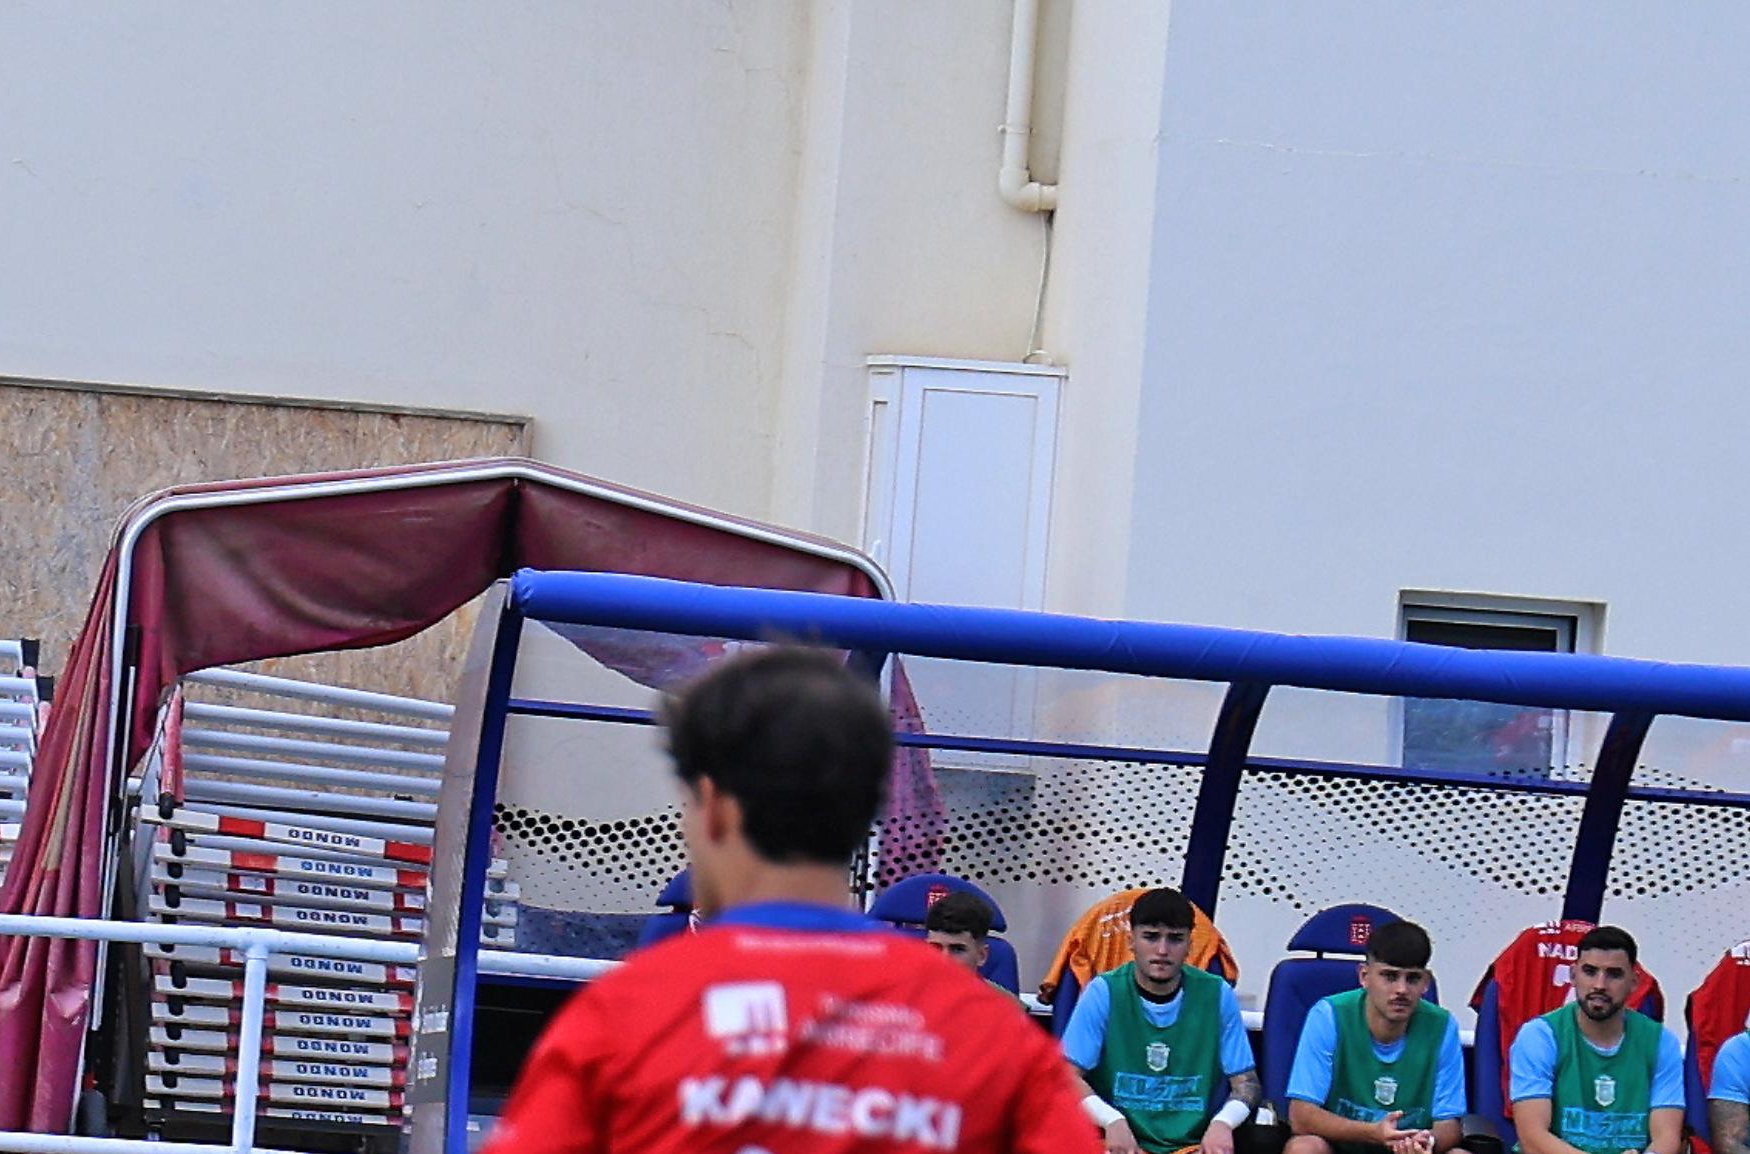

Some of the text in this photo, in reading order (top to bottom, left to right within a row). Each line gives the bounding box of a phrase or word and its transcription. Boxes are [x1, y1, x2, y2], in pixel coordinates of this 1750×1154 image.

[288, 829, 360, 848] MONDO
[301, 861, 372, 877] MONDO
[298, 884, 369, 900] MONDO
[296, 910, 368, 925] MONDO
[291, 957, 362, 973] MONDO
[302, 990, 374, 1004] MONDO
[300, 1014, 371, 1029] MONDO
[297, 1040, 369, 1055] MONDO
[297, 1064, 368, 1078] MONDO
[294, 1087, 365, 1101] MONDO
[677, 1076, 963, 1152] KAWECKI
